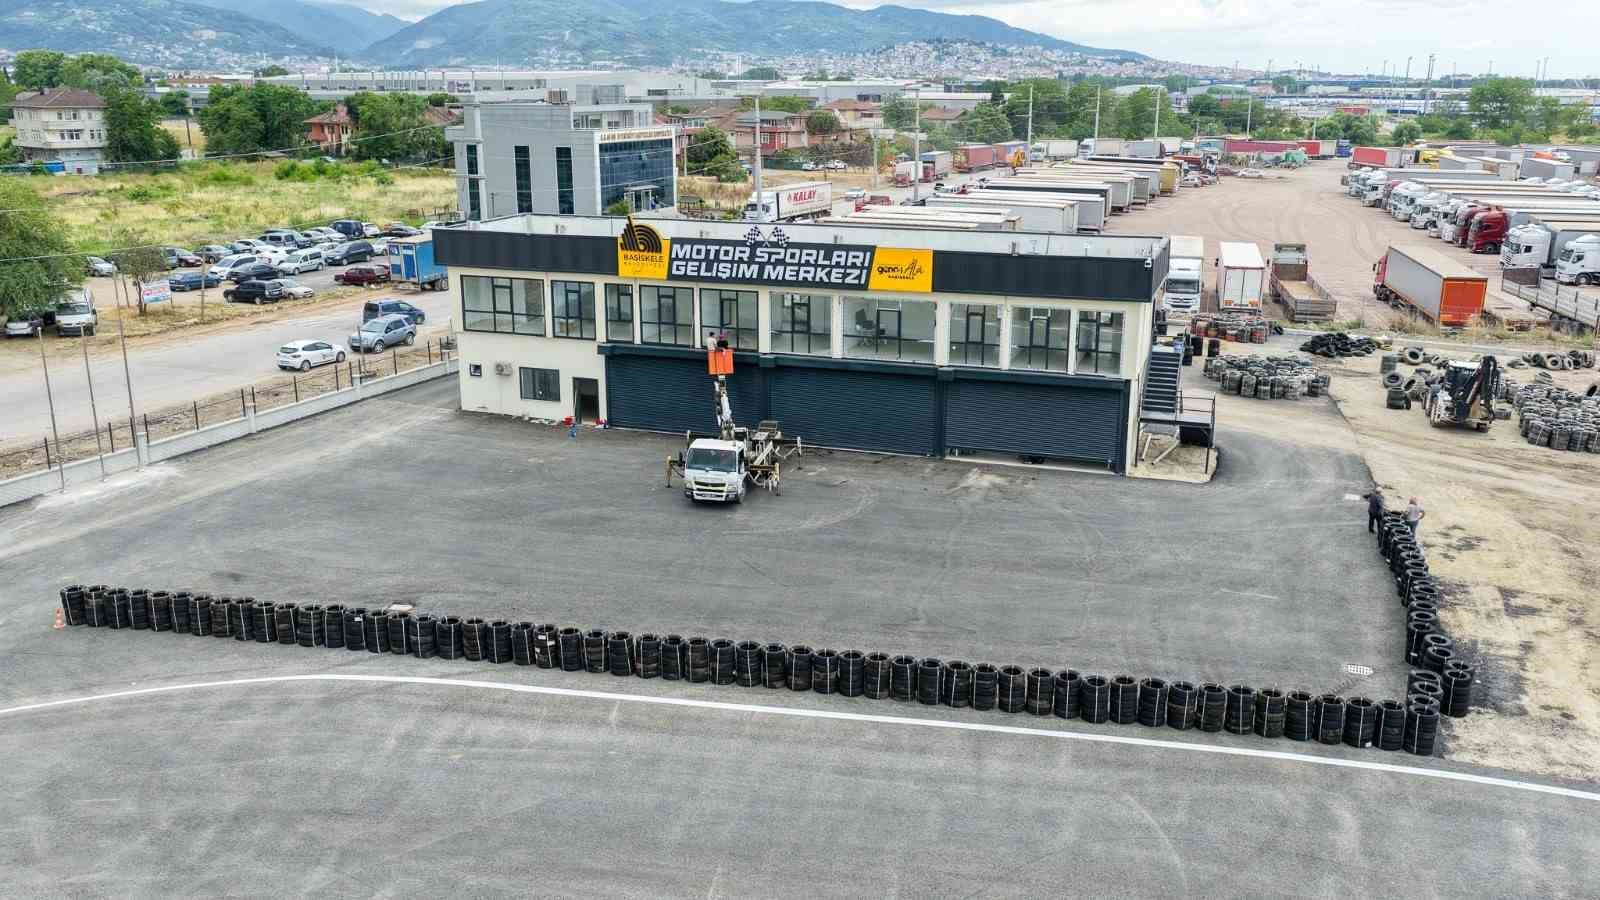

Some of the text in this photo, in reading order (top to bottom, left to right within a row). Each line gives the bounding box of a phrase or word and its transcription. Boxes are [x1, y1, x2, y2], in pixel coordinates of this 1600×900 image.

[793, 190, 817, 202] KALAY
[671, 244, 871, 267] MOTOR SPORLARI
